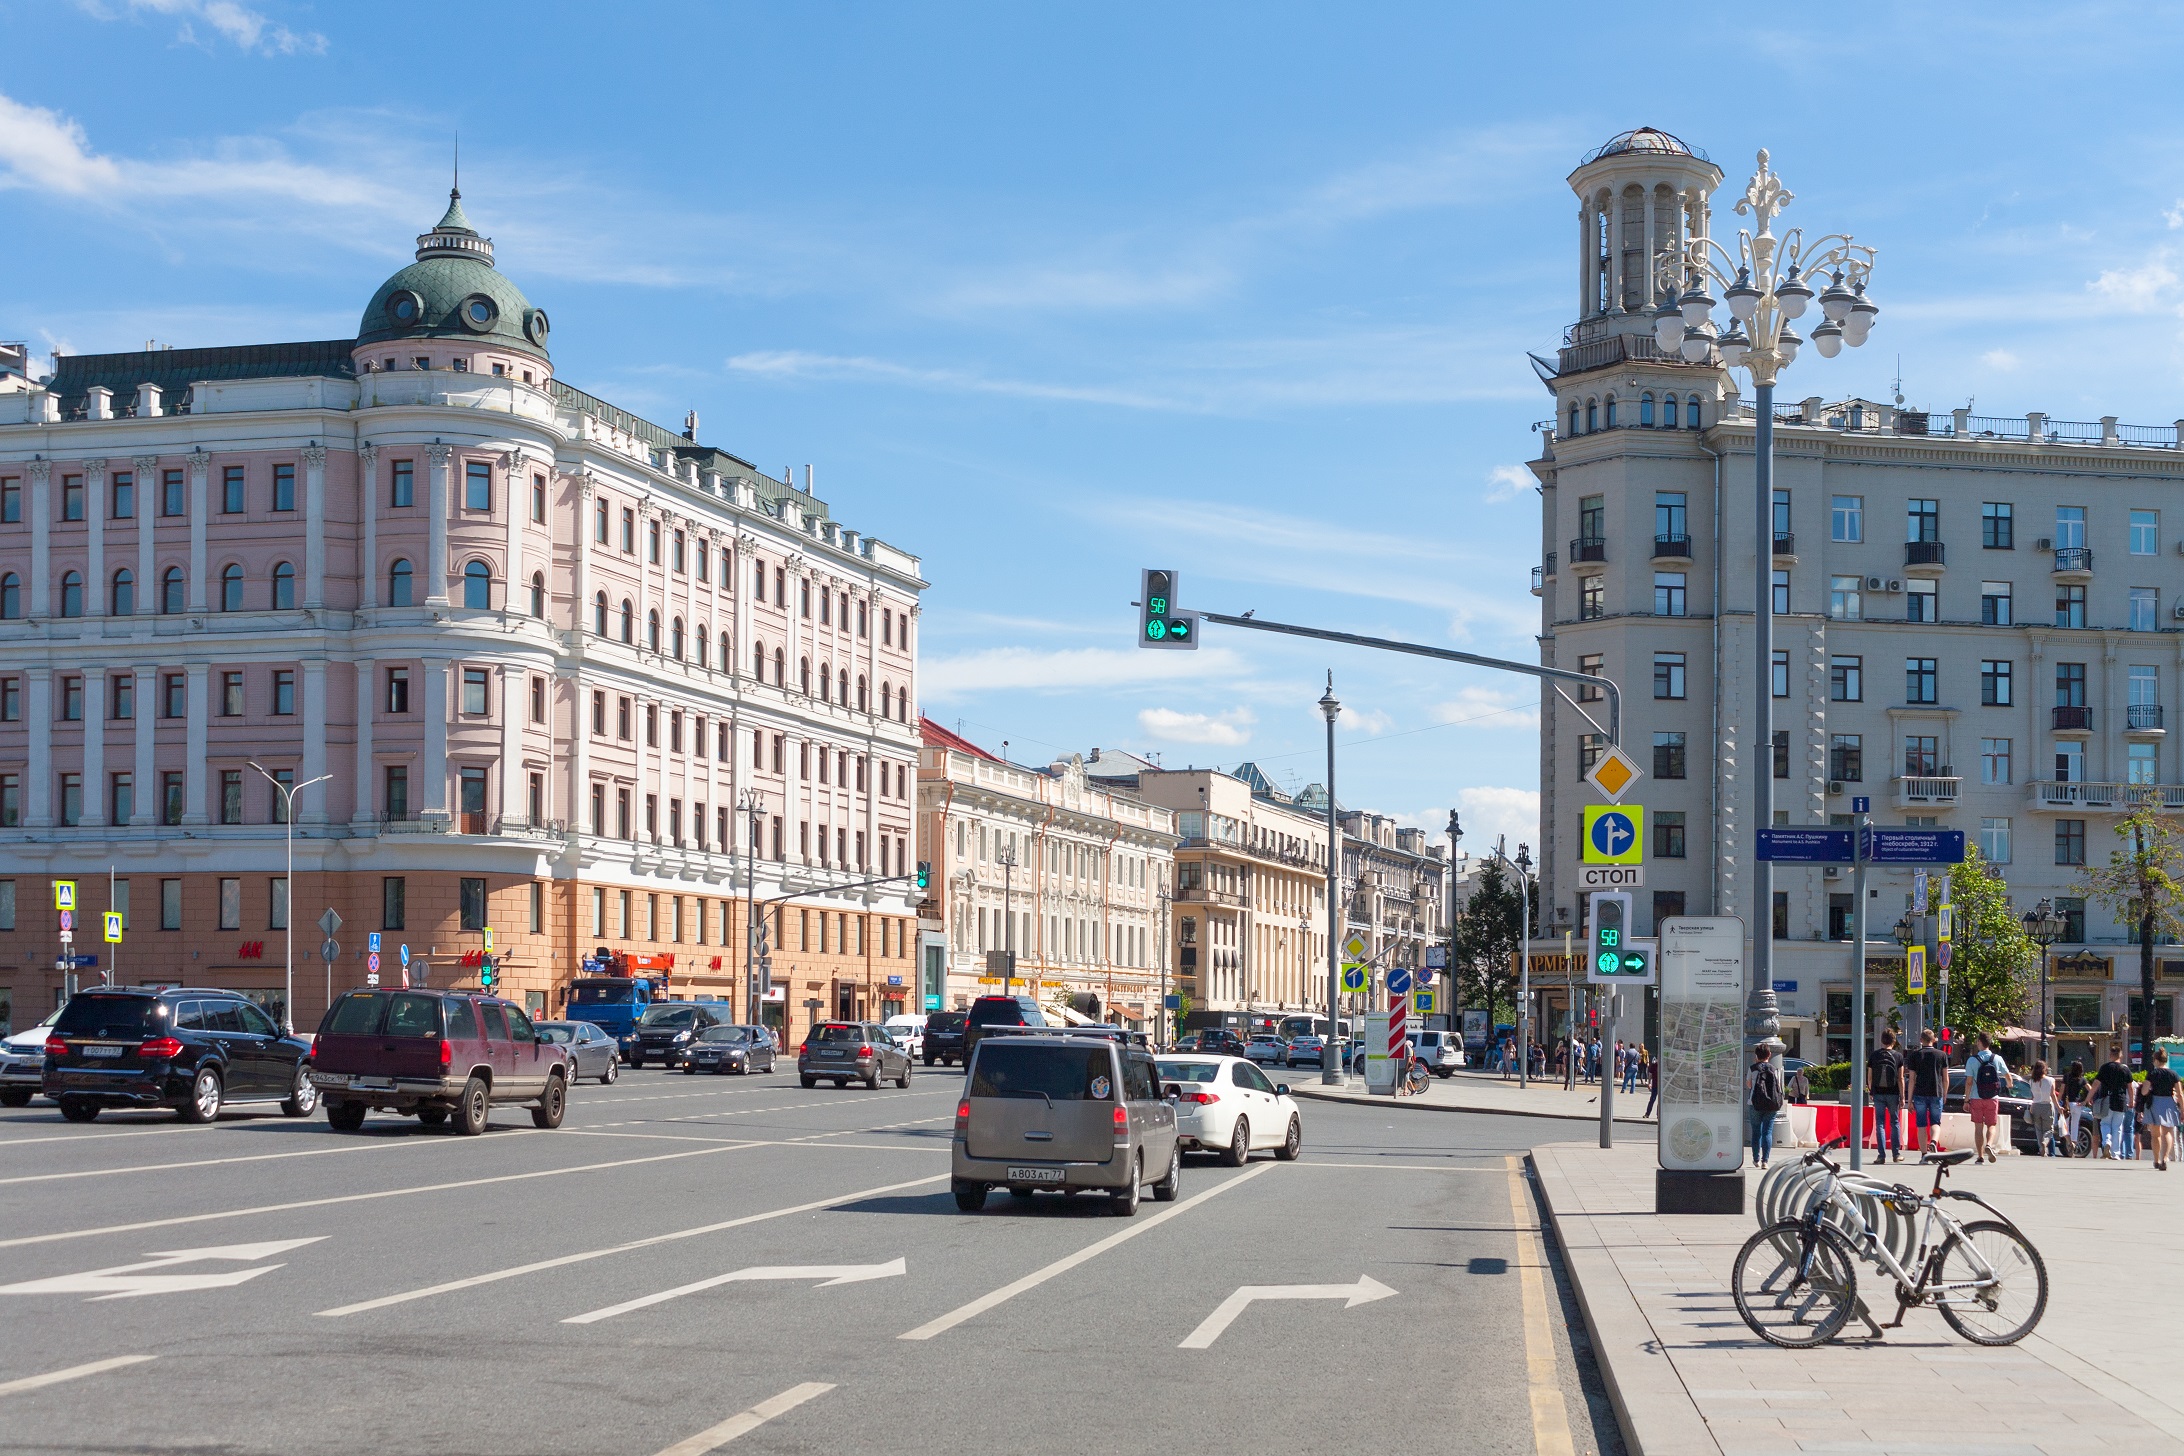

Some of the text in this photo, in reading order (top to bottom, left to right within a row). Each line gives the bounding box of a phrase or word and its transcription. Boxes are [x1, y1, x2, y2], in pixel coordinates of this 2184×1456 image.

[1150, 597, 1166, 614] 58
[1585, 869, 1637, 884] СТОП
[1601, 929, 1618, 947] 58
[1527, 954, 1589, 972] АРМЕНИ
[1011, 1169, 1062, 1180] А803АТ 77
